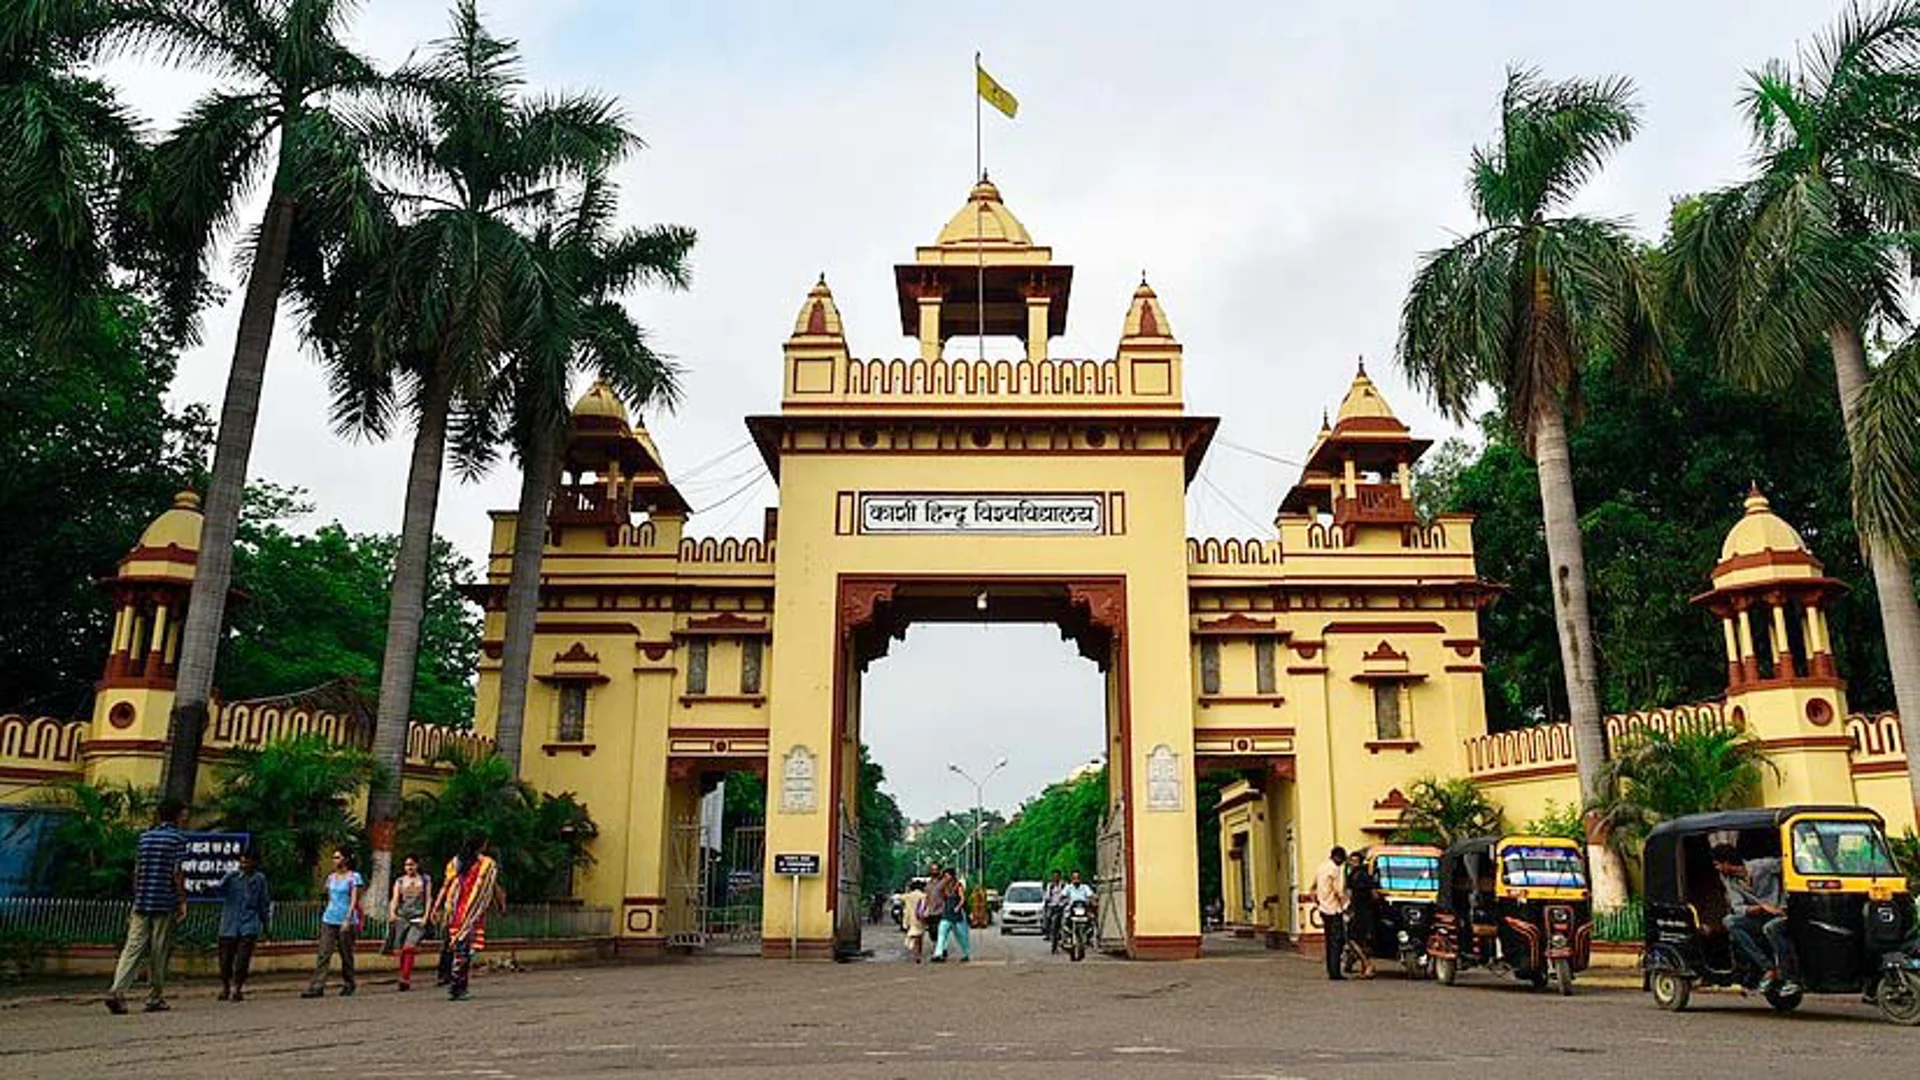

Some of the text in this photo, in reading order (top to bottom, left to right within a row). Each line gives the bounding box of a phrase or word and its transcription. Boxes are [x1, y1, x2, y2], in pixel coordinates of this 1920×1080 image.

[869, 500, 1094, 528] काशी हिन्दू विश्वविद्यालय
